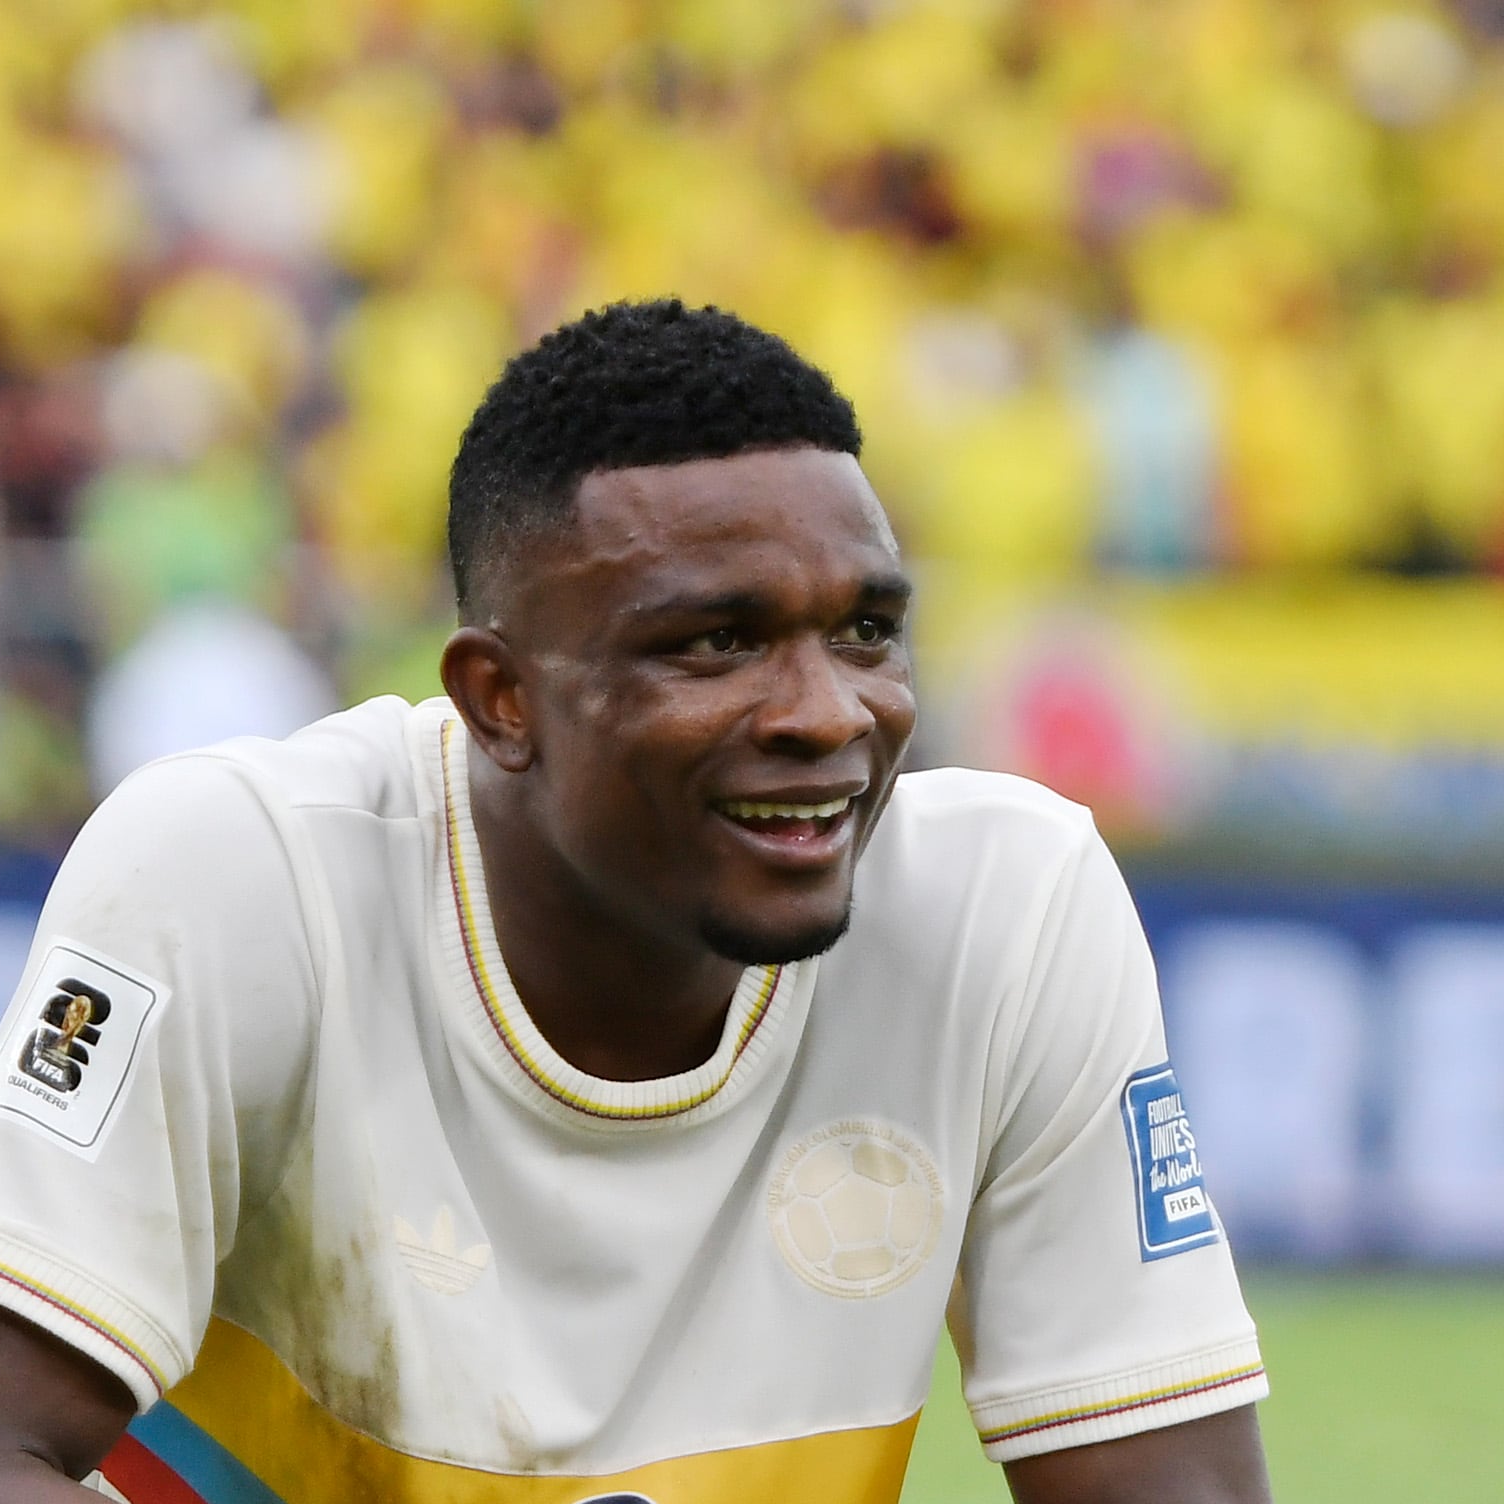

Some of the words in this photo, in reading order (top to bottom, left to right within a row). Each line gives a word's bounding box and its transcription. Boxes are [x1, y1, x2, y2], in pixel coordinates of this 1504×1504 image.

[32, 1057, 65, 1084] FIFA
[7, 1074, 70, 1112] QUALIFIERS
[1149, 1117, 1197, 1162] UNITES
[1166, 1149, 1202, 1188] Worl
[1169, 1194, 1201, 1214] FIFA
